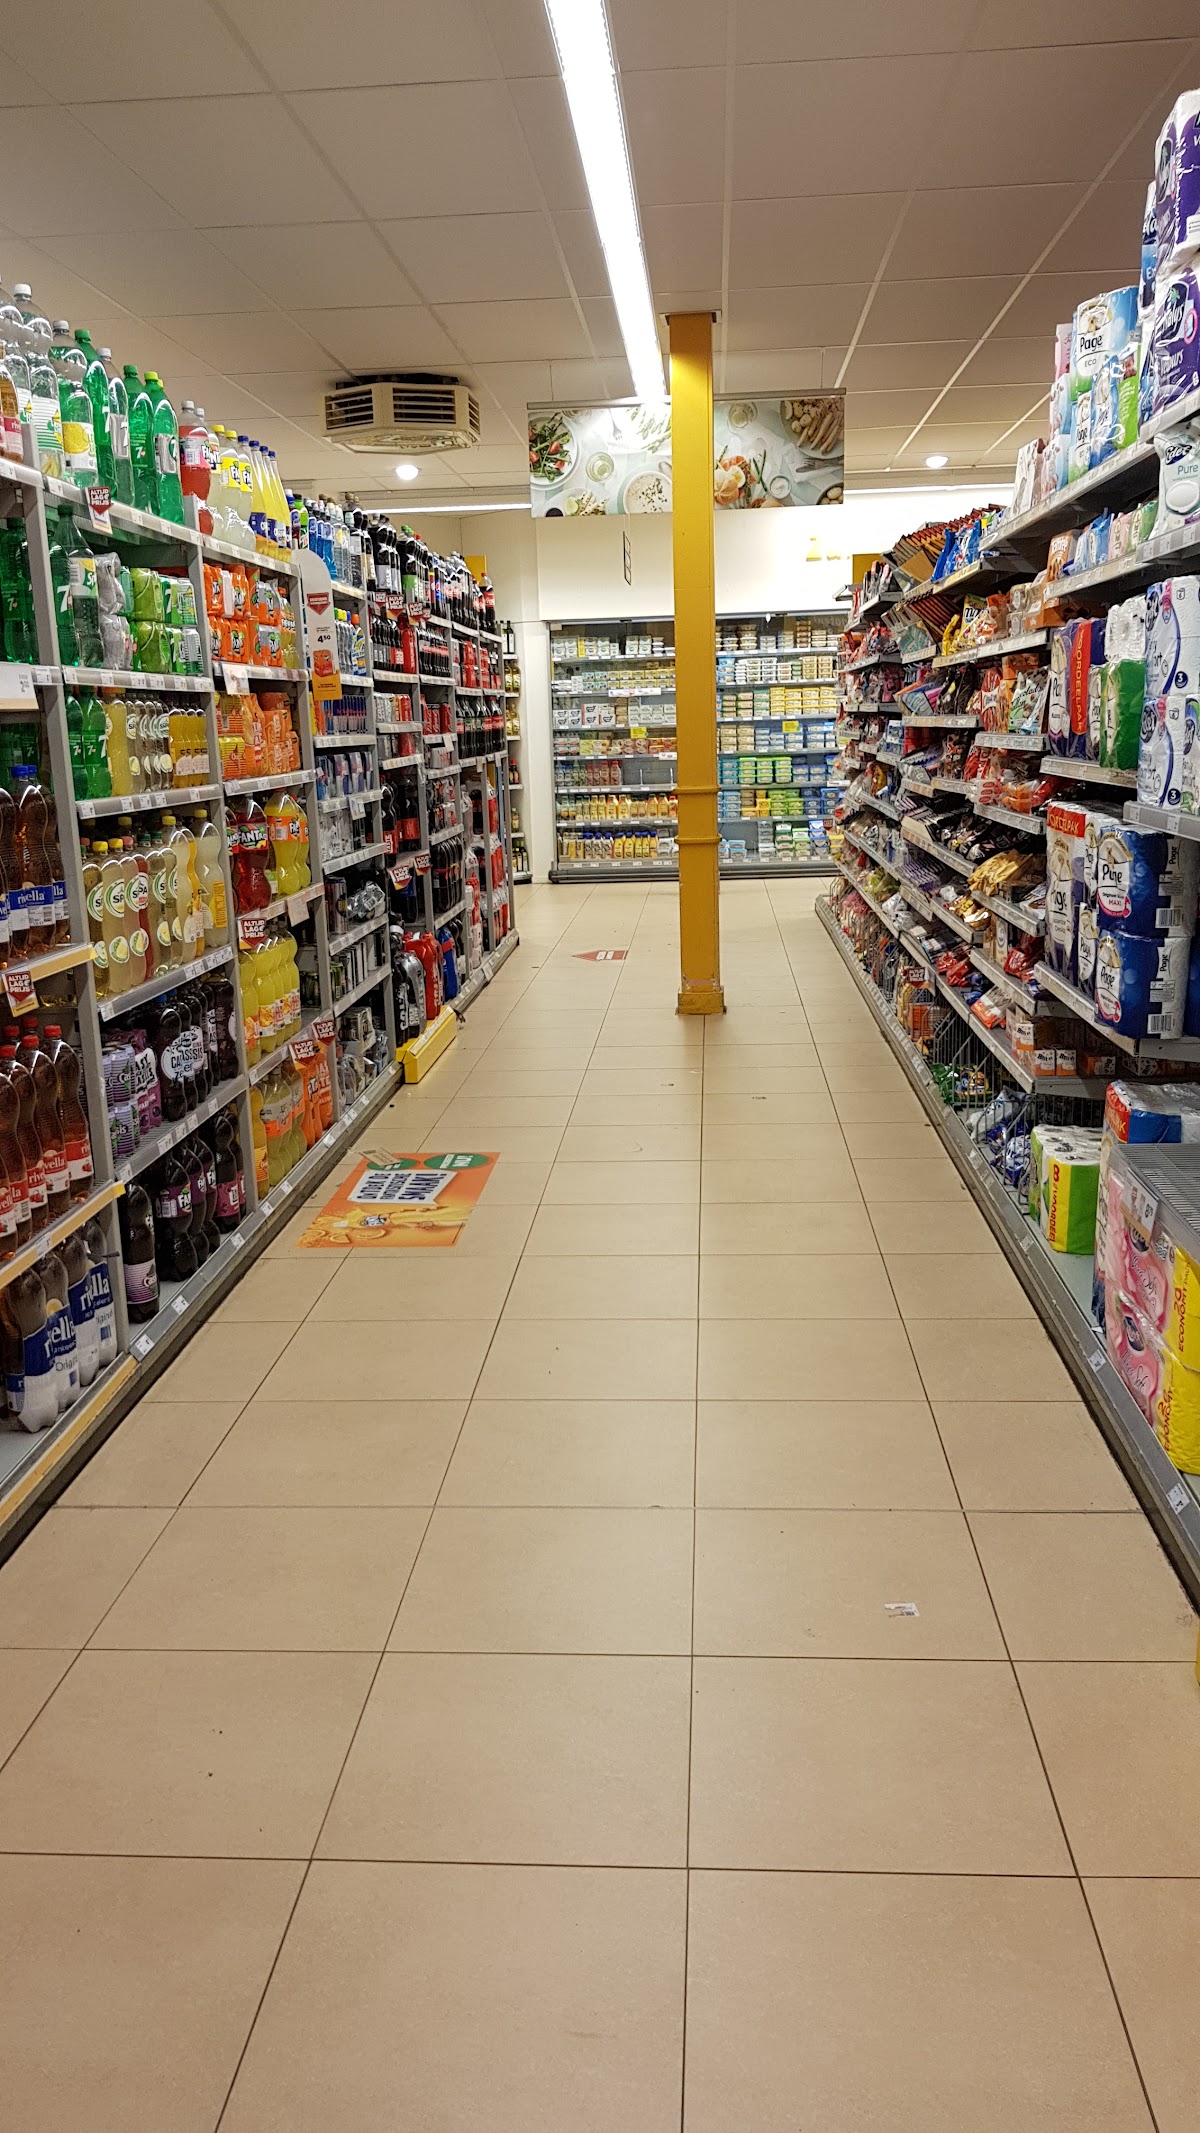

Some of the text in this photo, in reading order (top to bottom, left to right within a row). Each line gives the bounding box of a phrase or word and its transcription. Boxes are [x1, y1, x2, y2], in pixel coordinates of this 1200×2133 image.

[1080, 335, 1103, 352] Page
[1084, 358, 1097, 368] ECO
[1177, 464, 1199, 476] Pure
[1177, 673, 1183, 682] 3
[1170, 790, 1177, 800] 3
[1168, 846, 1179, 865] Page
[1159, 954, 1169, 972] Page
[8, 974, 30, 982] ALTIJD
[44, 1156, 65, 1169] vella
[1053, 1163, 1060, 1183] 8
[1174, 1287, 1183, 1313] 20
